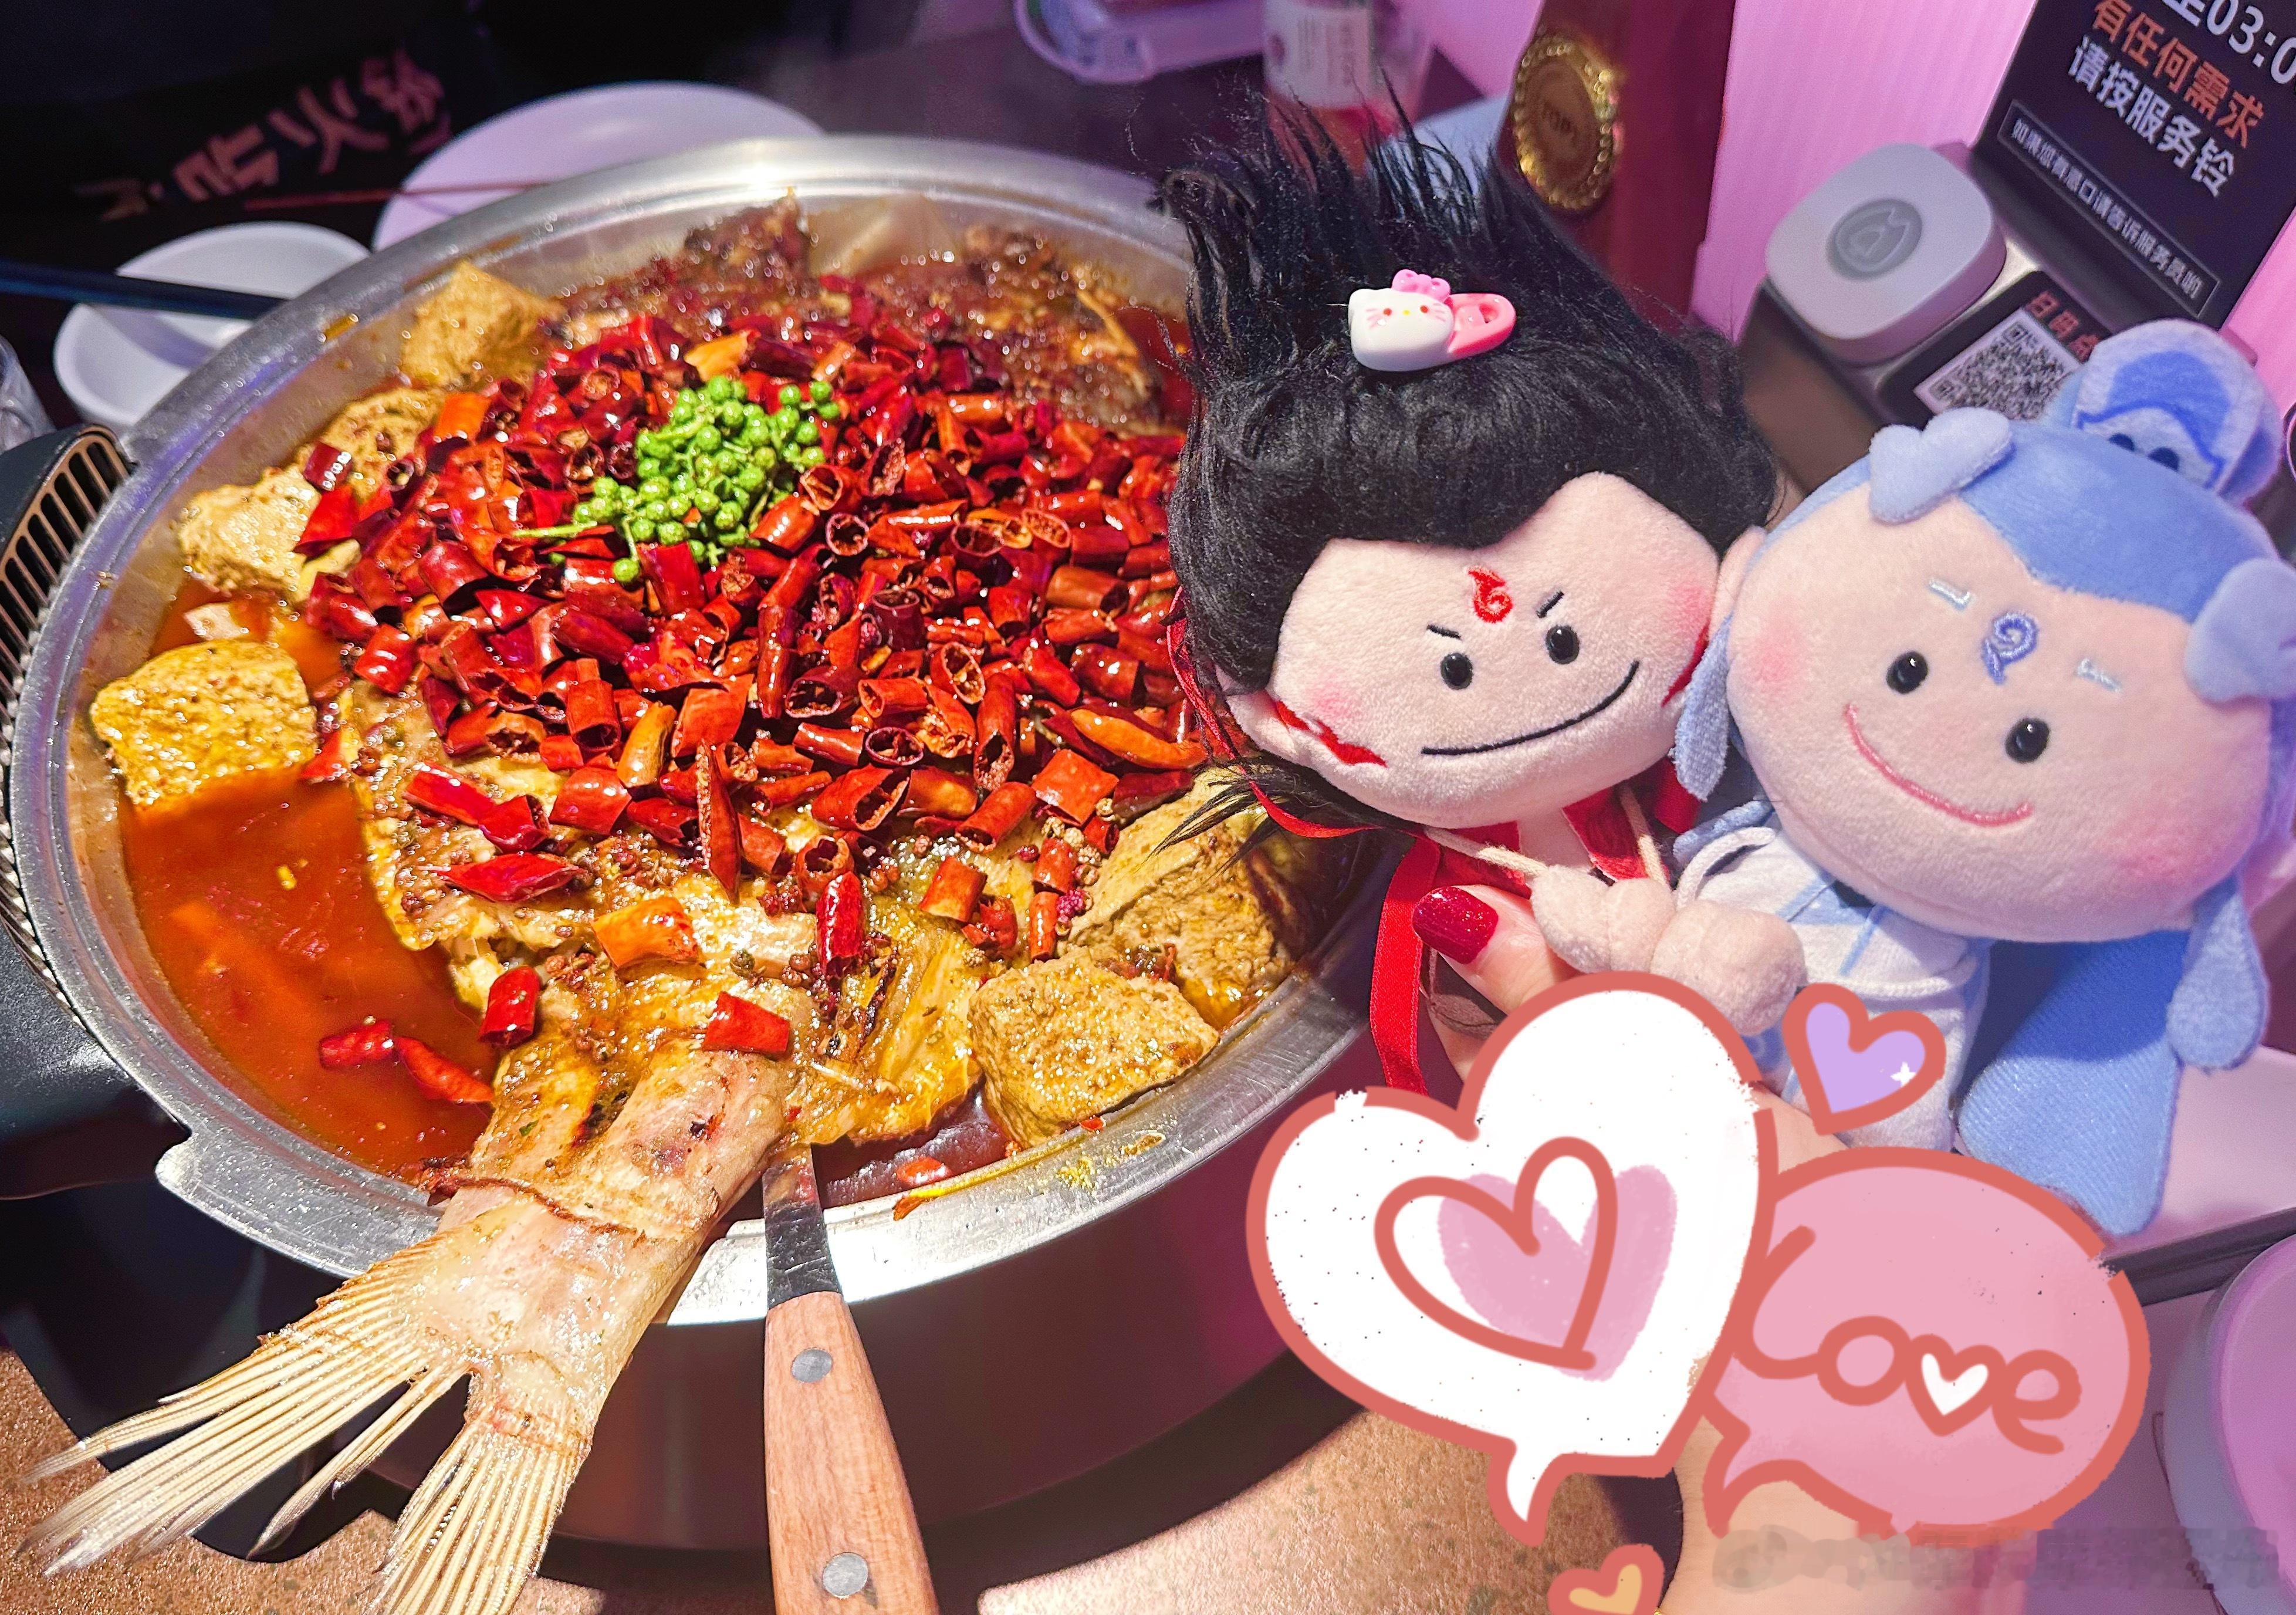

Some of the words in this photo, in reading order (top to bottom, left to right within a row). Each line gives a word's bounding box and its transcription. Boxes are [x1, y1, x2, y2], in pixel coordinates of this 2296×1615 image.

[2068, 35, 2235, 197] 请按服务铃
[2092, 0, 2264, 148] 有任何需求
